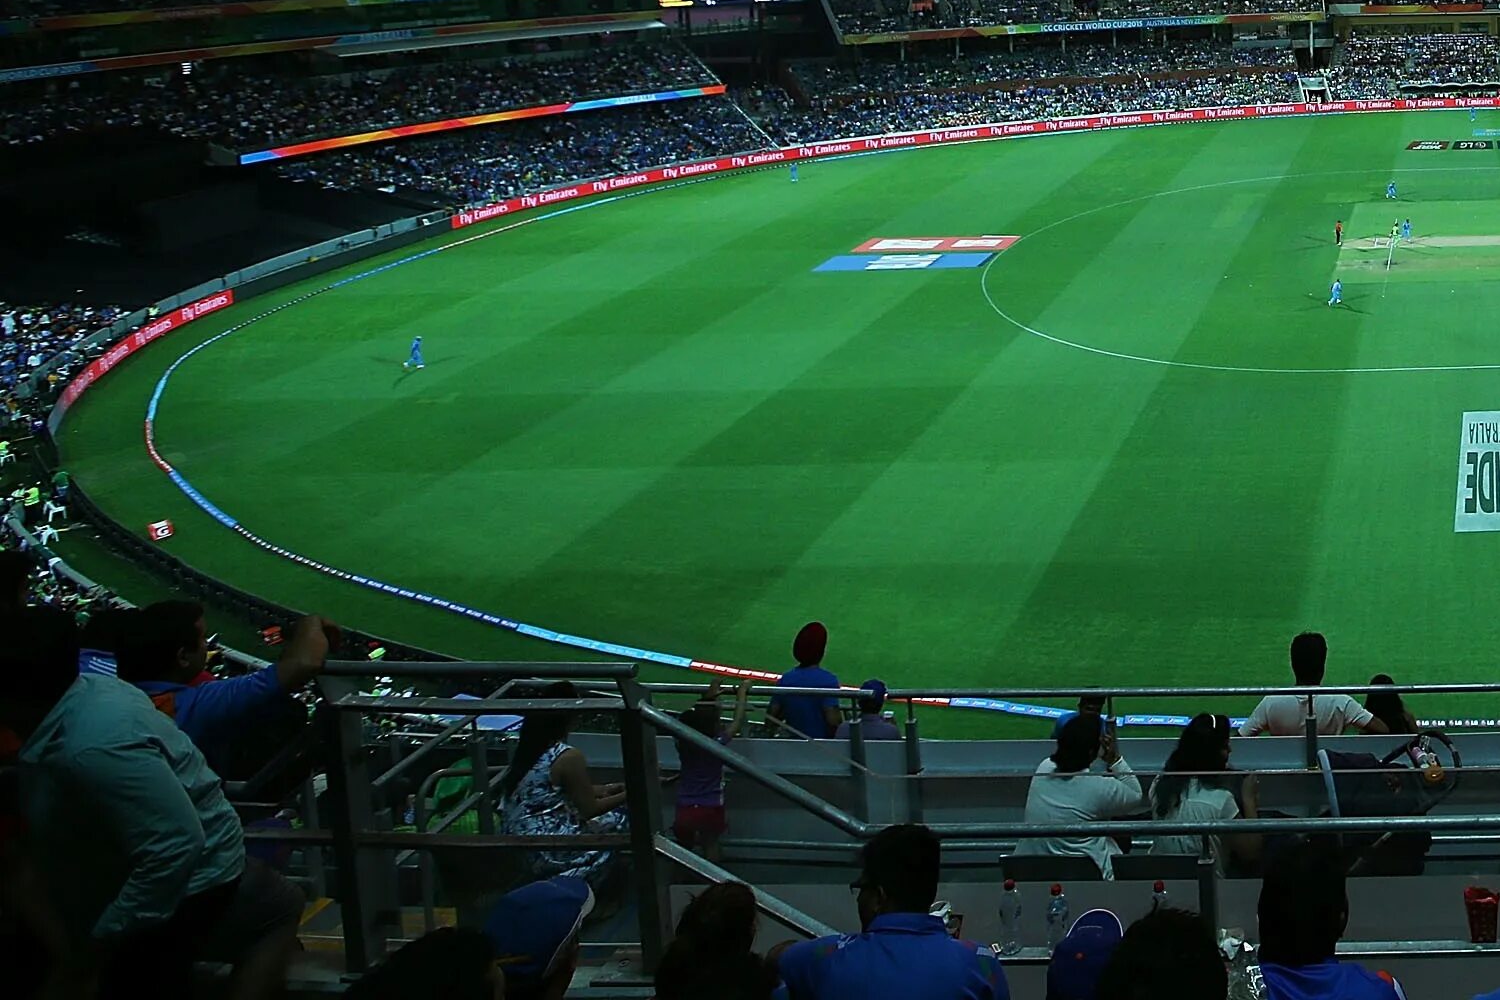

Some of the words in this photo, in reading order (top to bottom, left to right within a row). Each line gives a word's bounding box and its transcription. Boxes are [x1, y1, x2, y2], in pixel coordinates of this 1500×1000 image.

[1305, 104, 1316, 112] Fly
[1405, 100, 1416, 108] Fly
[1455, 99, 1466, 107] Fly
[1003, 125, 1034, 133] Emirates
[1045, 122, 1058, 130] Fly
[944, 130, 977, 139] Emirates
[864, 140, 878, 148] Fly
[879, 137, 915, 146] Emirates
[799, 148, 813, 156] Fly
[815, 144, 851, 153] Emirates
[731, 158, 746, 166] Fly
[748, 153, 784, 163] Emirates
[662, 169, 677, 177] Fly
[678, 163, 716, 174] Emirates
[592, 182, 607, 191] Fly
[609, 175, 647, 187] Emirates
[521, 197, 536, 206] Fly
[539, 189, 577, 202] Emirates
[459, 214, 472, 224] Fly
[474, 205, 508, 219] Emirates
[194, 296, 227, 314] Emirates
[156, 525, 169, 536] G
